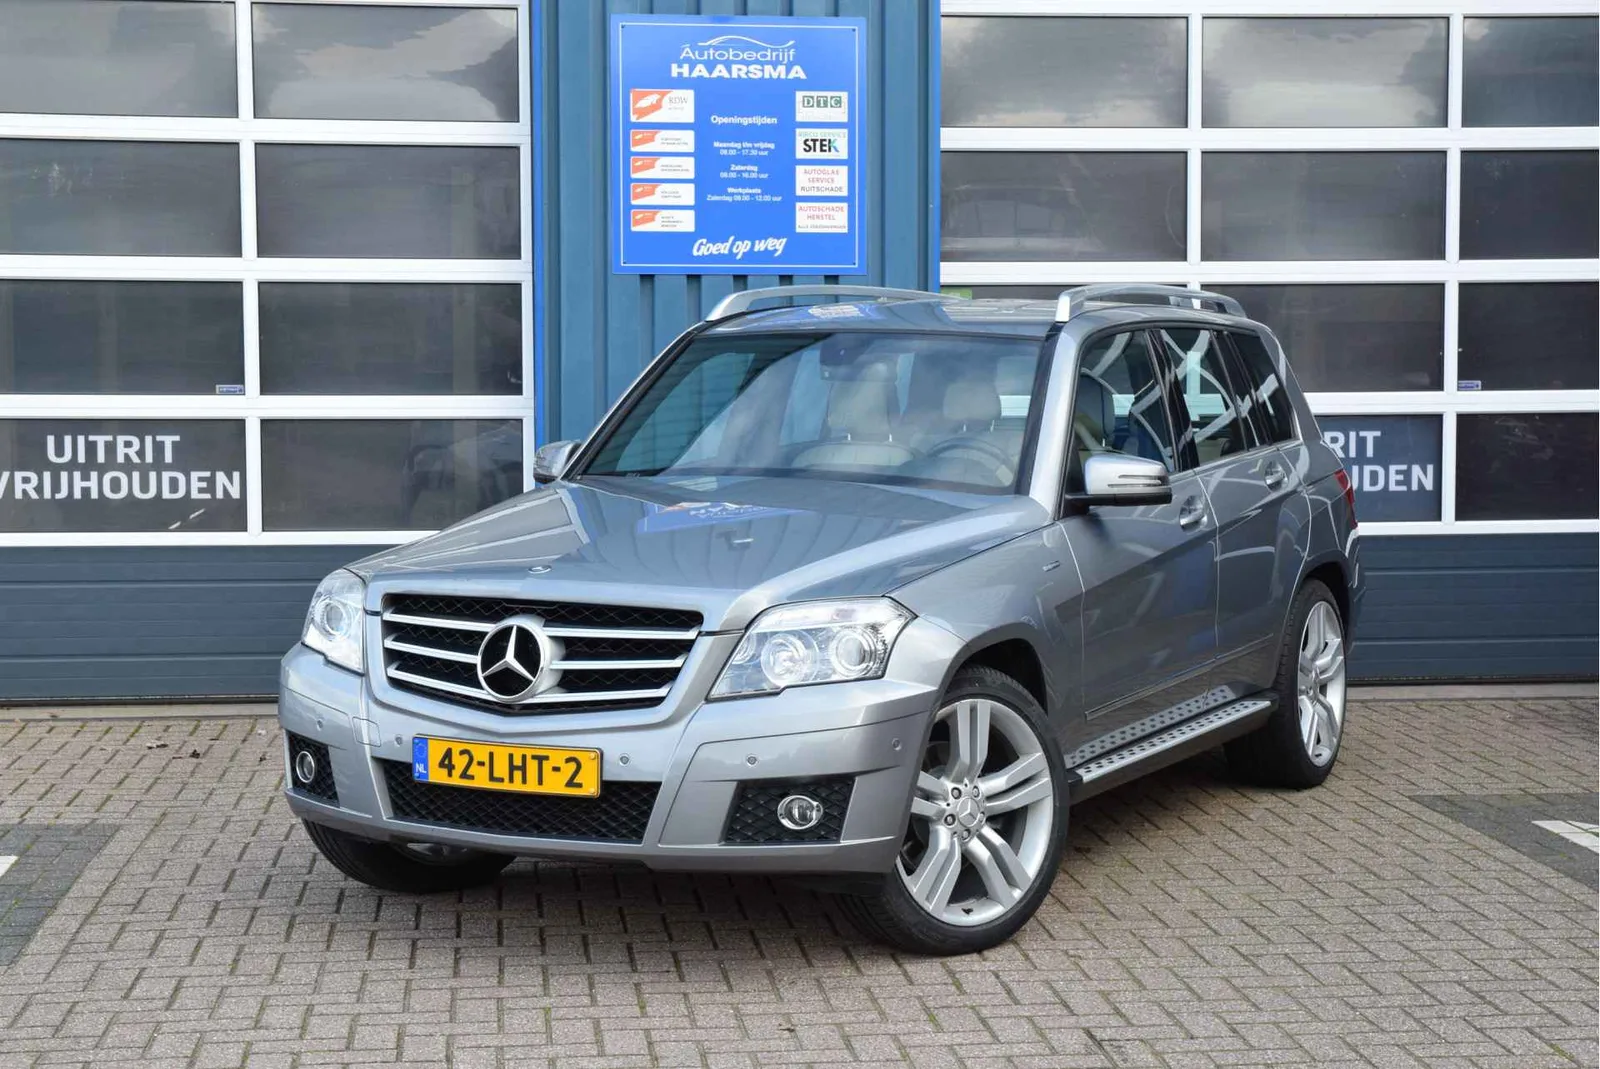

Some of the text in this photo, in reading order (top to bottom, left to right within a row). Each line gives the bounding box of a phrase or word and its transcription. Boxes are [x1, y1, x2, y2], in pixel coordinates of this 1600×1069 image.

[679, 45, 796, 64] Autobedrijf
[671, 63, 807, 79] HAARSMA
[802, 95, 842, 108] DTC
[710, 114, 778, 126] Openingstijden
[713, 141, 741, 149] Maandag
[803, 138, 840, 153] STEK
[730, 164, 758, 172] Zaterdag
[692, 235, 788, 260] Goed op weg
[46, 434, 181, 464] UITRIT
[1323, 430, 1382, 459] RIT
[415, 763, 428, 774] NL
[438, 747, 584, 789] 42-LHT-2
